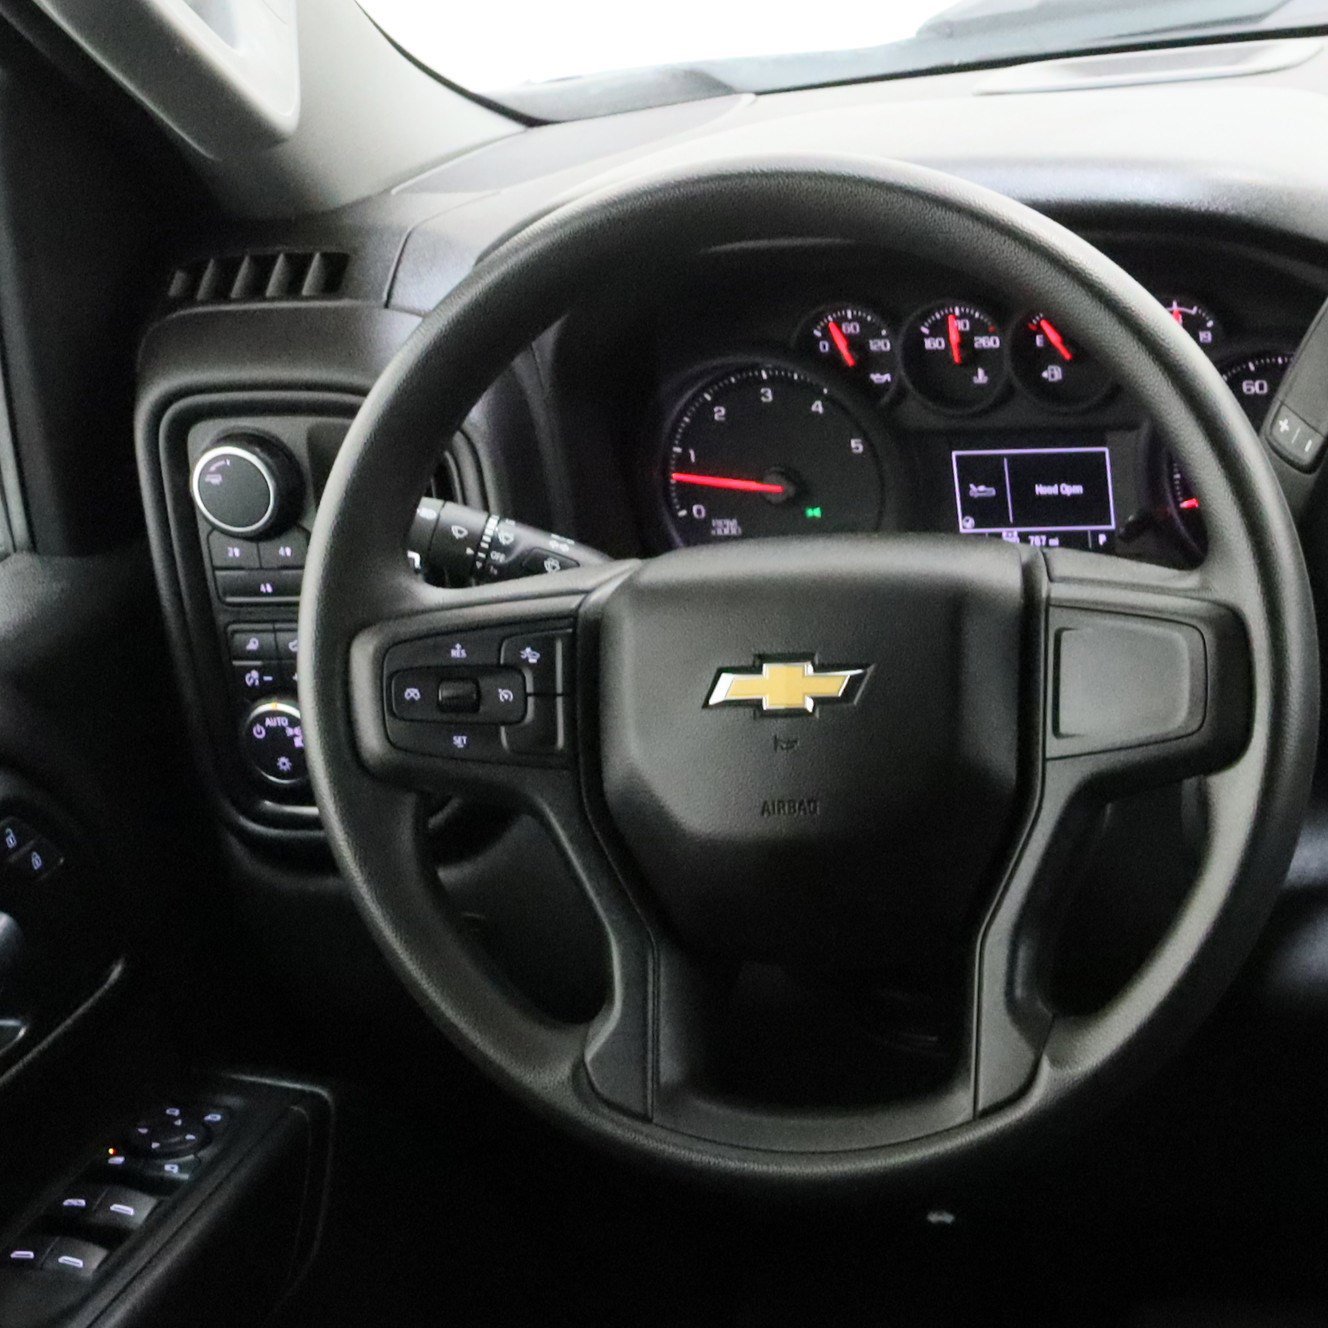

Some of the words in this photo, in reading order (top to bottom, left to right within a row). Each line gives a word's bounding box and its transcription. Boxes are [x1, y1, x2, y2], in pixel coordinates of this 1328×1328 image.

[842, 322, 860, 334] 60
[819, 341, 829, 353] 0
[869, 339, 891, 351] 120
[924, 337, 945, 350] 160
[974, 336, 1000, 349] 260
[1036, 335, 1044, 347] E
[1242, 380, 1268, 394] 60
[761, 388, 773, 403] 3
[713, 406, 726, 421] 2
[811, 401, 823, 414] 4
[851, 439, 863, 453] 5
[692, 504, 705, 519] 0
[265, 717, 288, 727] AUTO
